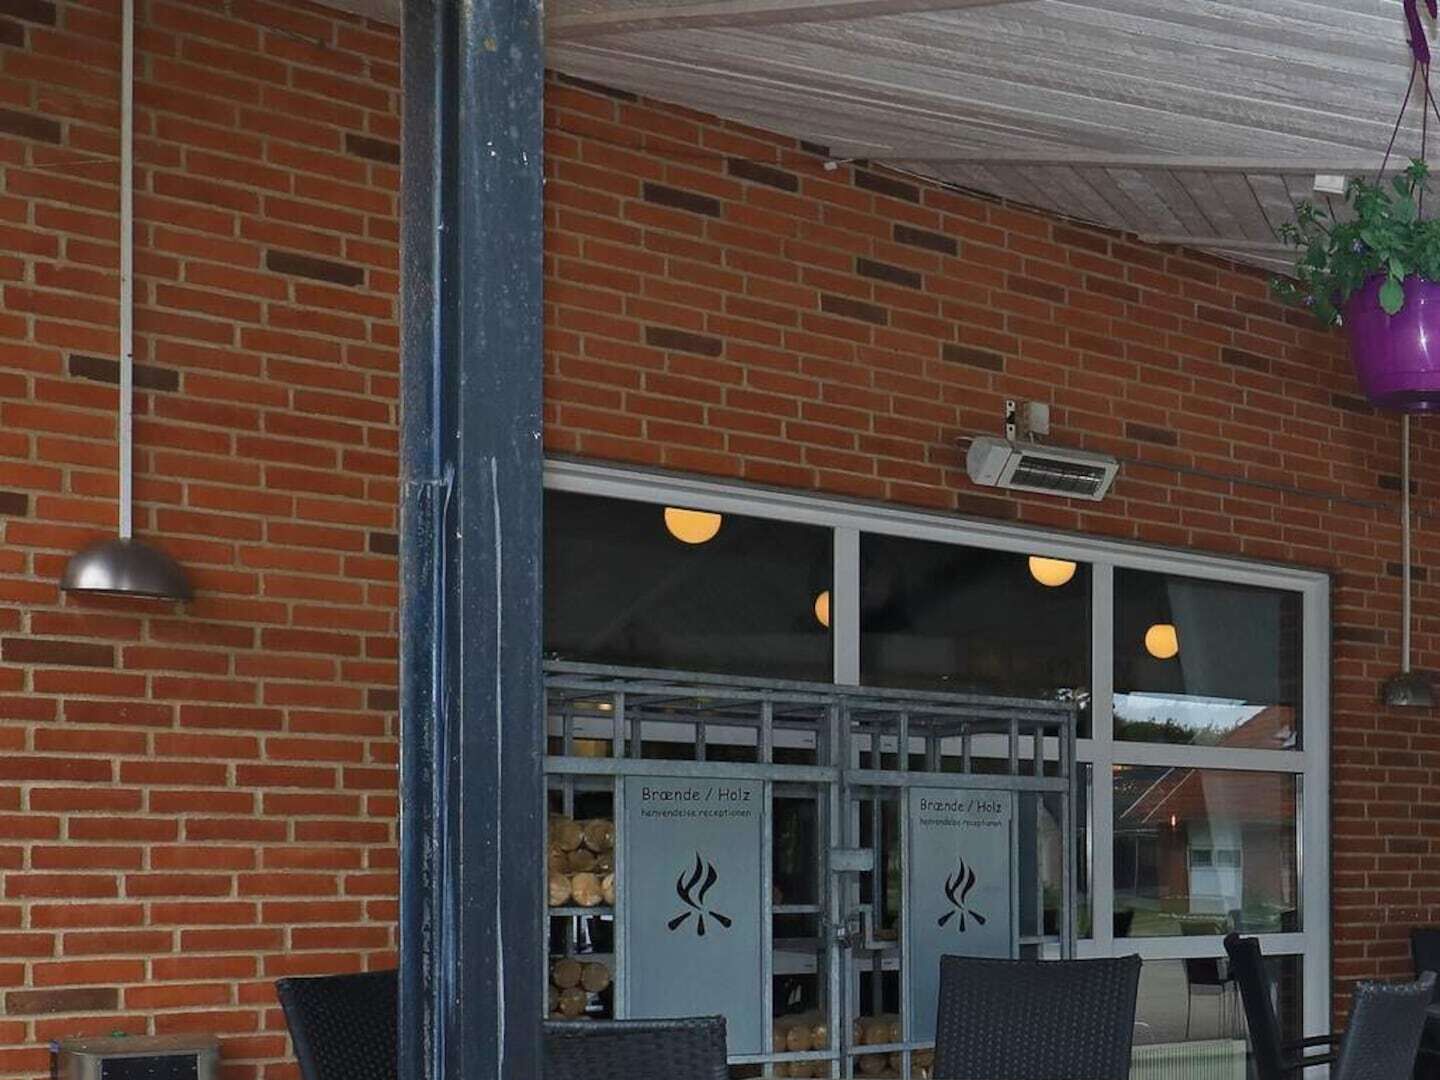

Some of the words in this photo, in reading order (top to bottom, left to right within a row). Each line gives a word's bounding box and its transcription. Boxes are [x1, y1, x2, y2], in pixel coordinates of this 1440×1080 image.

[642, 786, 700, 801] Brænde
[706, 787, 713, 801] /
[718, 787, 752, 801] Holz
[920, 798, 964, 812] Brænde
[967, 799, 974, 813] /
[976, 800, 1002, 813] Holz
